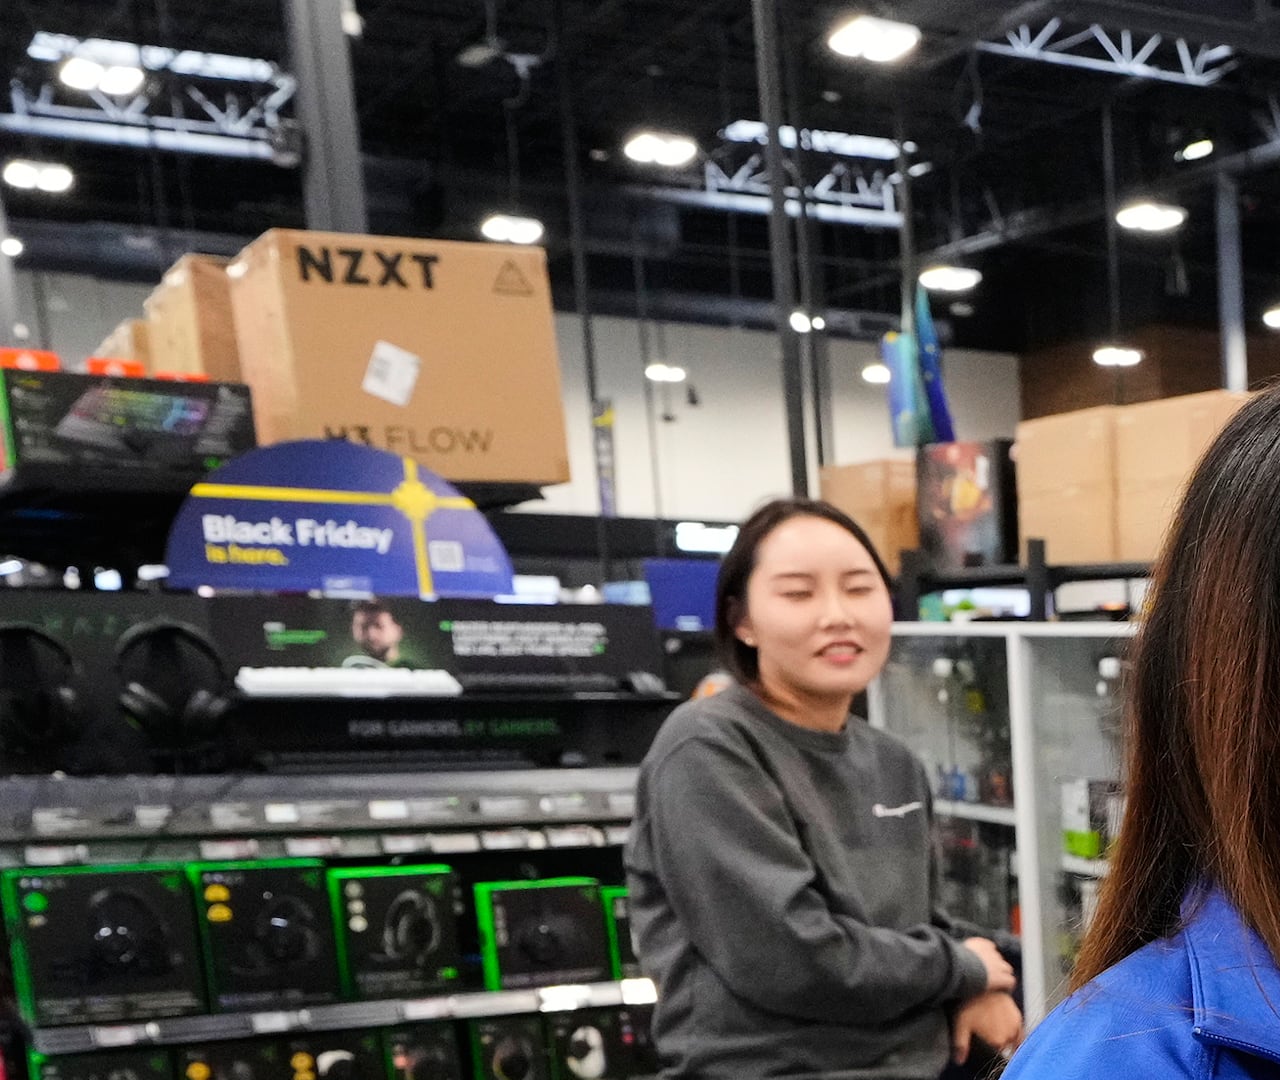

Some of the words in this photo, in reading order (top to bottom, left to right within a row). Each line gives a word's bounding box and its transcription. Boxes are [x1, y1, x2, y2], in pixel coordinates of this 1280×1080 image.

[297, 245, 440, 290] NZXT
[384, 425, 494, 453] FLOW
[202, 514, 295, 545] Black
[295, 518, 393, 555] Friday
[205, 544, 229, 563] is
[228, 544, 290, 566] here.
